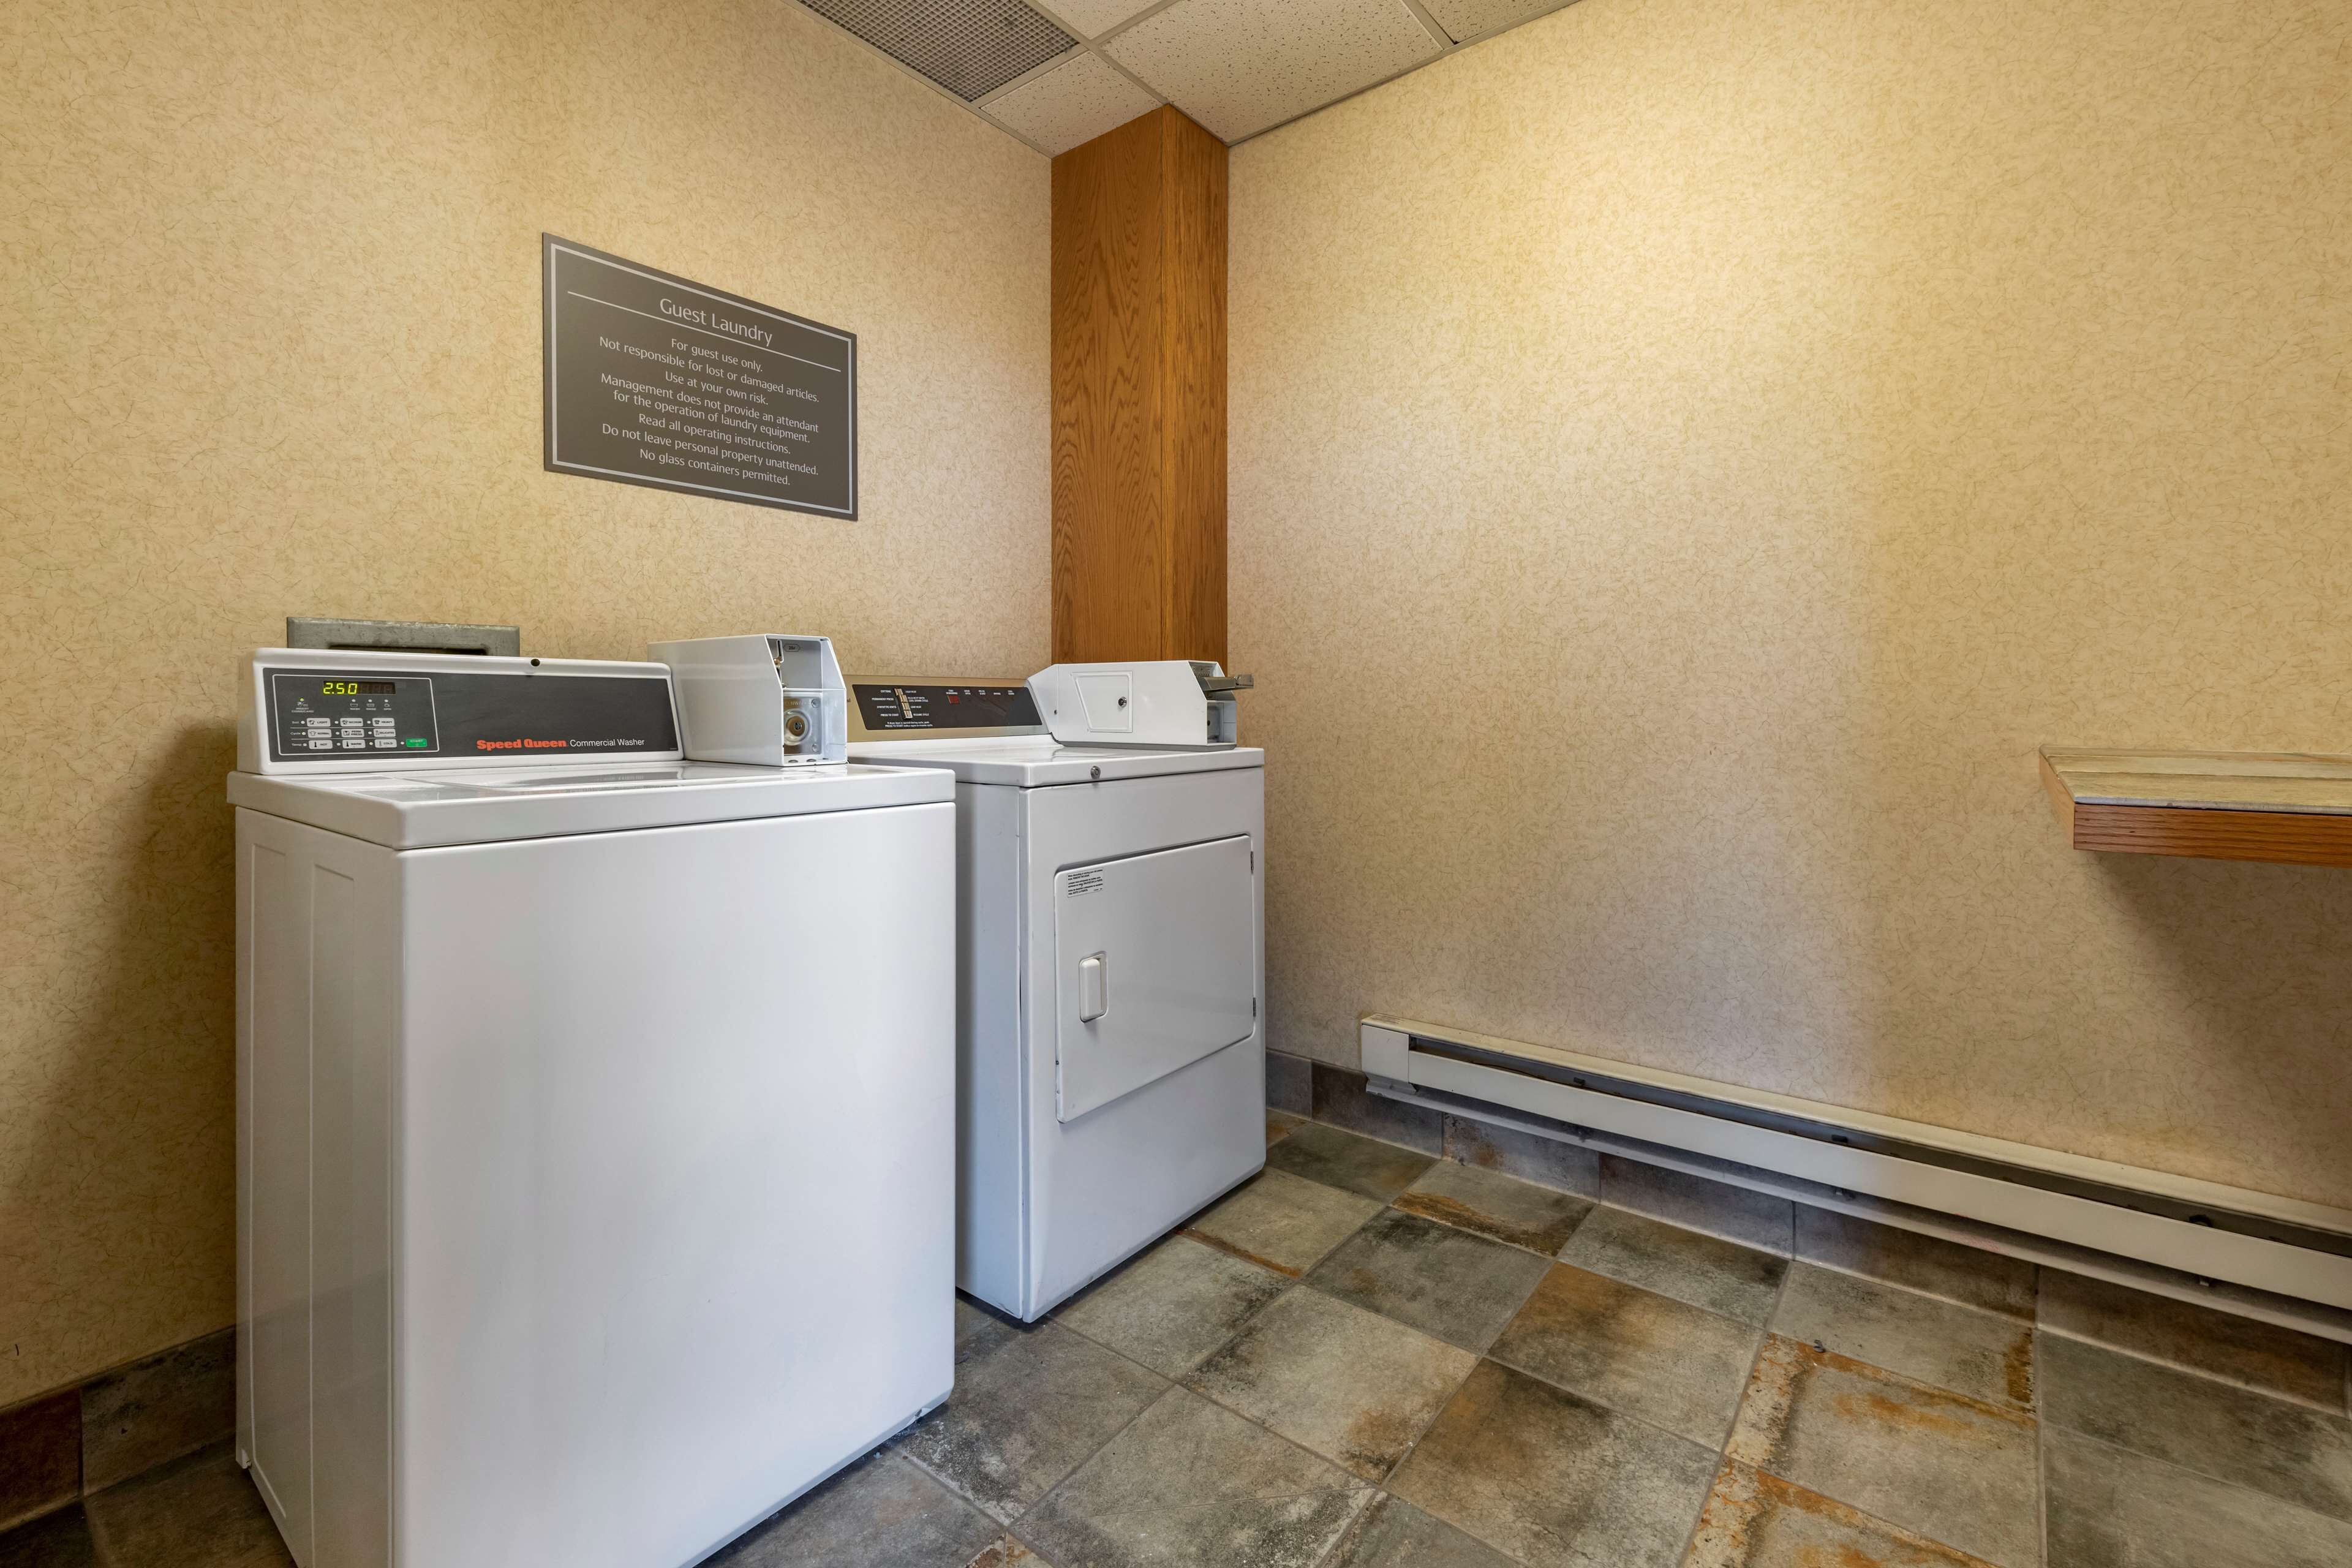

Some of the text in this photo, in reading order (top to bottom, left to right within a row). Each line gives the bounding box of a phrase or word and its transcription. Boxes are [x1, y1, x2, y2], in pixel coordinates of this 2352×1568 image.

[660, 298, 772, 347] Guest Laundry
[600, 336, 820, 402] Not responsible for lost or damaged articles.
[671, 338, 763, 373] For guest use only.
[601, 373, 819, 433] Management does not provide an attendant
[665, 371, 768, 405] Use at your own risk.
[613, 390, 810, 443] for the operation of laundry equipment.
[639, 413, 791, 454] Read all operating instructions.
[602, 423, 818, 475] Do not leave personal property unattended.
[640, 448, 790, 485] No glass containers permitted.
[323, 682, 358, 694] 2.50
[477, 739, 522, 750] Speed
[524, 738, 567, 748] Queen
[570, 739, 616, 747] Commercial
